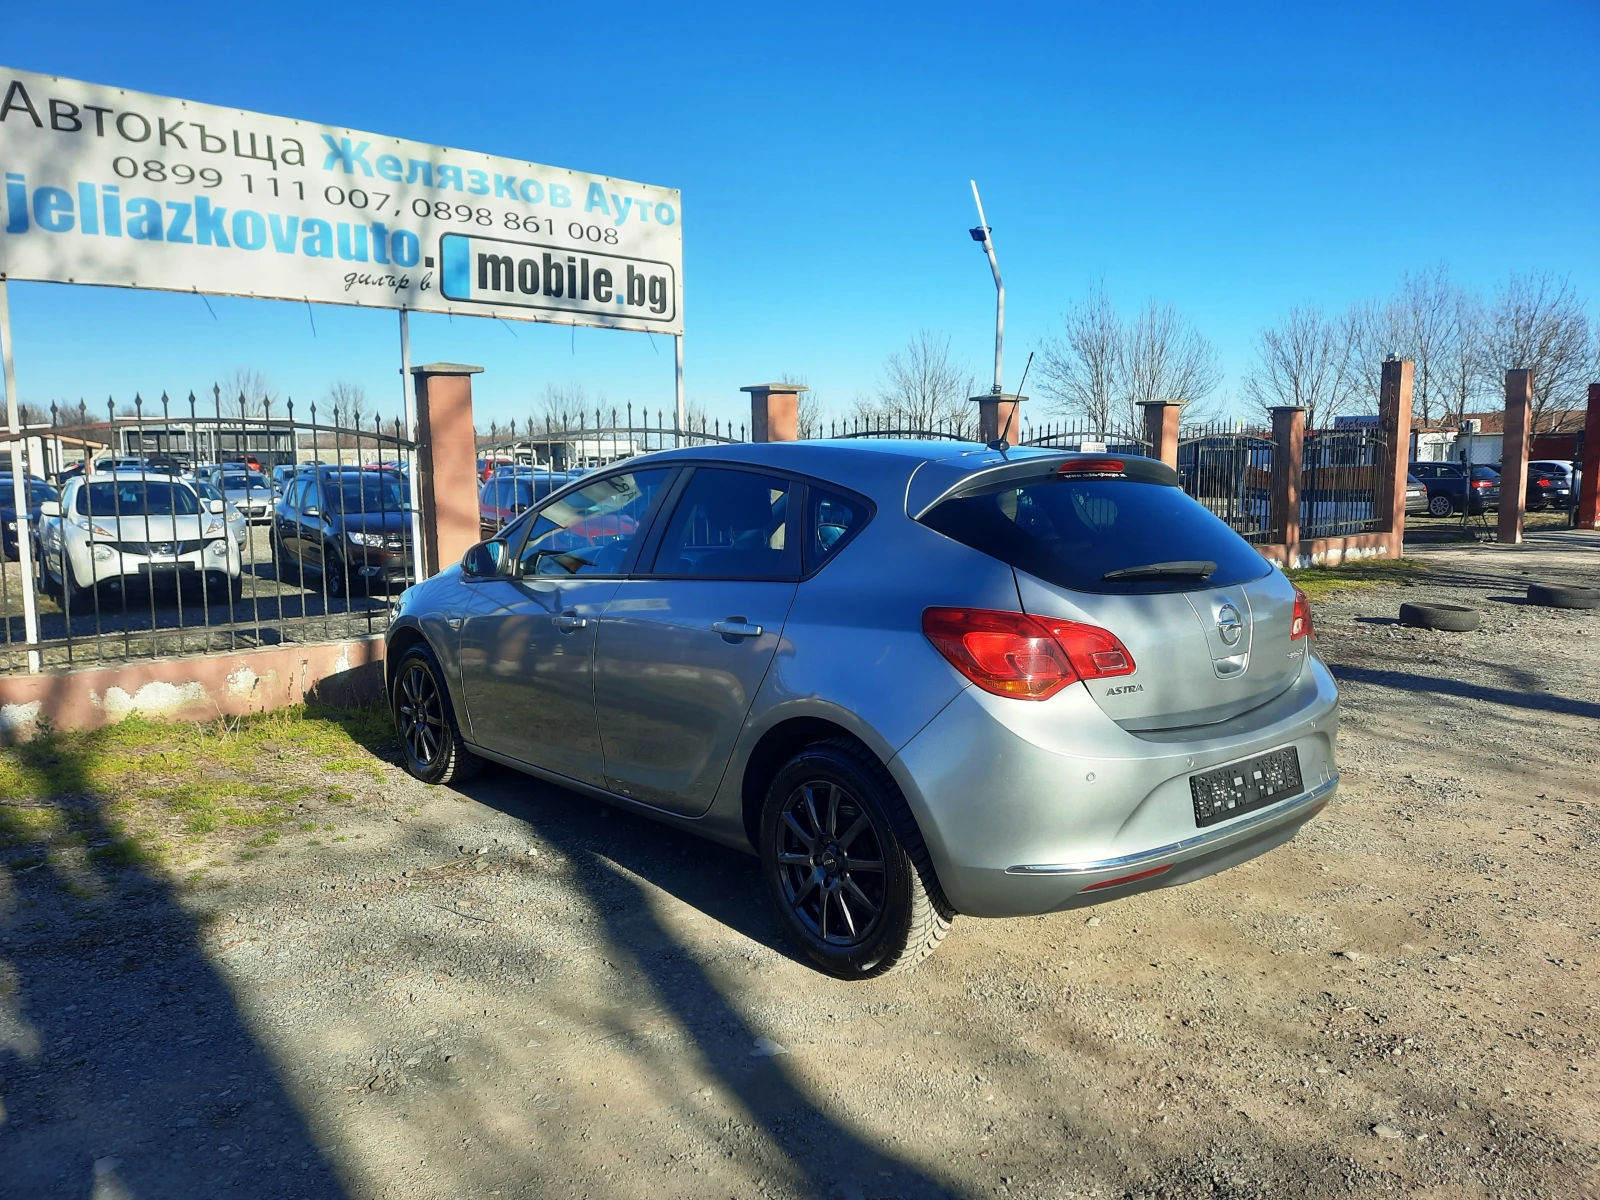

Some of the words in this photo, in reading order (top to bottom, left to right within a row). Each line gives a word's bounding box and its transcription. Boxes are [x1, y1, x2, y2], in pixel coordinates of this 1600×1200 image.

[0, 80, 305, 170] Автокъща
[320, 134, 573, 209] Желязков
[584, 182, 676, 227] Ауто
[112, 156, 223, 188] 0899
[241, 174, 304, 200] 111
[324, 186, 400, 216] 007,
[412, 198, 493, 226] 0898
[504, 212, 554, 235] 861
[568, 222, 619, 245] 008
[477, 252, 667, 314] mobile.bg
[1106, 684, 1144, 696] ASTRA
